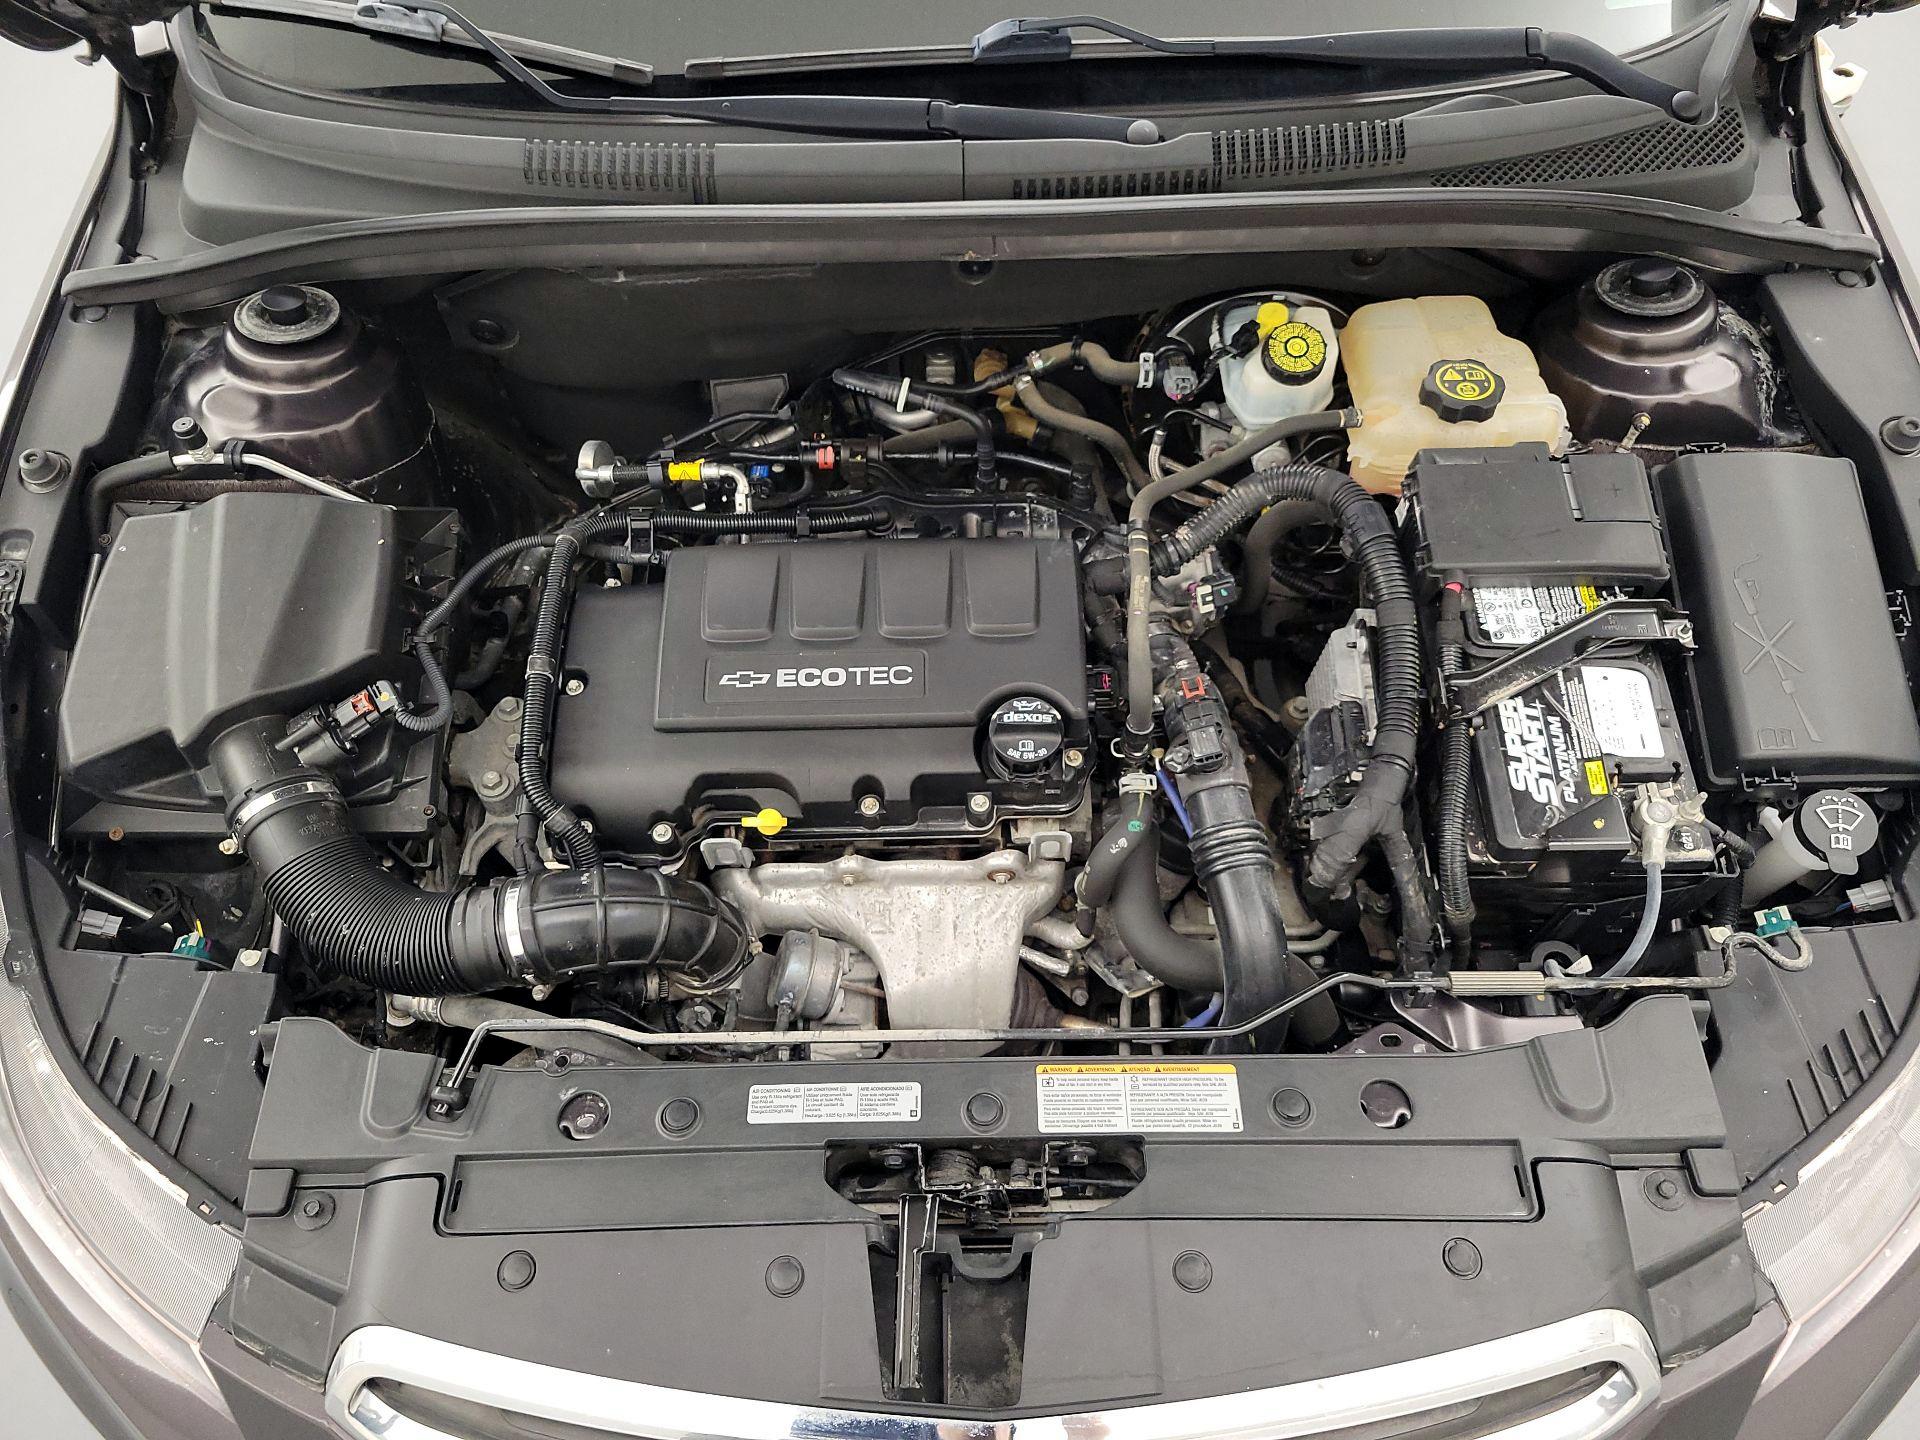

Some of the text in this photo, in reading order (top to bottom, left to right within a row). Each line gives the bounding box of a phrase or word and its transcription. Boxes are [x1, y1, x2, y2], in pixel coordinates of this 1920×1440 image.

[776, 665, 914, 688] ECOTEC
[1003, 711, 1055, 723] dexos
[1497, 698, 1528, 791] SUPER
[1006, 747, 1048, 760] SAE 5W-30
[1514, 696, 1561, 806] START
[1546, 715, 1579, 804] PLATINUM
